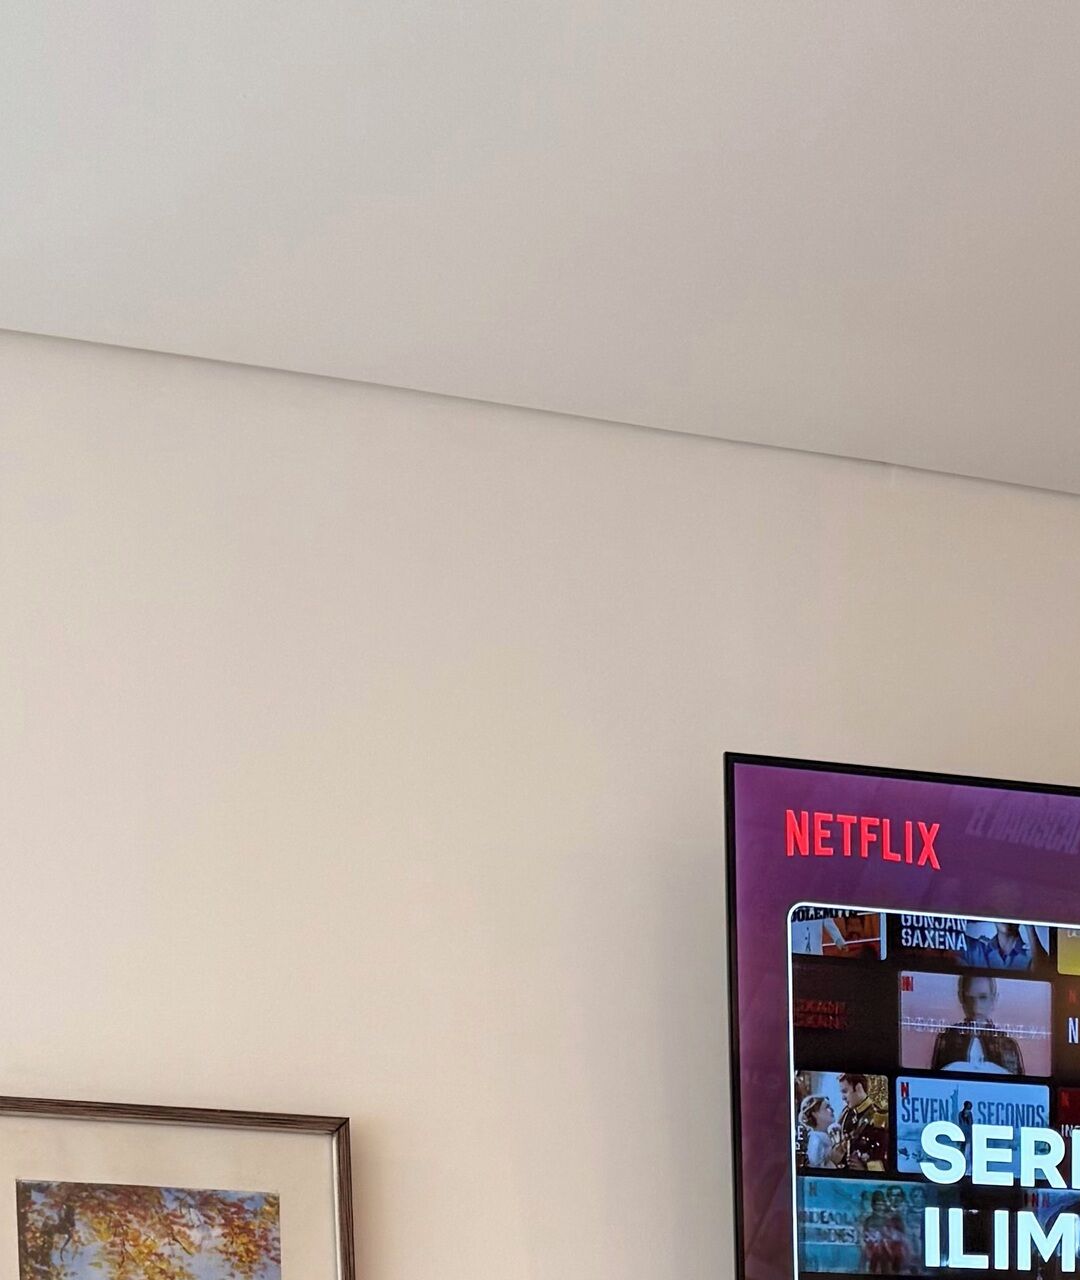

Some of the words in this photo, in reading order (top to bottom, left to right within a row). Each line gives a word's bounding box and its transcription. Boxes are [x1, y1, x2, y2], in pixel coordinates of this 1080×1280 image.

[786, 809, 940, 870] NETFLIX
[901, 930, 967, 951] SAXENA
[901, 1097, 949, 1124] SEVEN
[978, 1101, 1045, 1127] SECONDS
